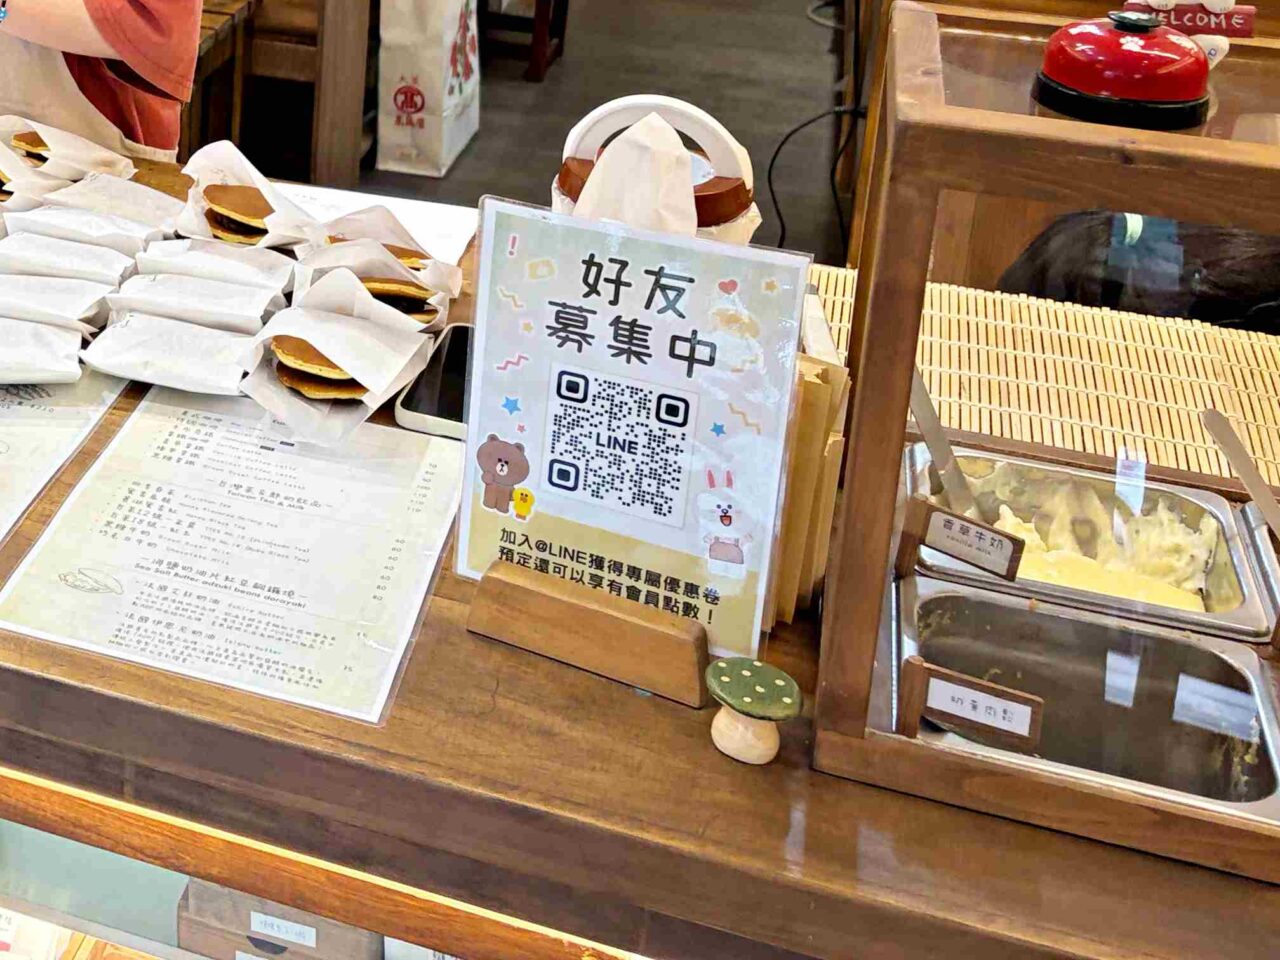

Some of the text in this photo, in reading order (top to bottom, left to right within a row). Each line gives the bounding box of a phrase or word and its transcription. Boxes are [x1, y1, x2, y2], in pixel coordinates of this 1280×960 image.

[582, 252, 697, 320] 好友
[545, 301, 719, 379] 募集中
[594, 431, 640, 457] LINE
[942, 517, 1004, 552] 香草牛奶
[132, 561, 307, 611] Sea Salt Butter adzuki beans dorayaki
